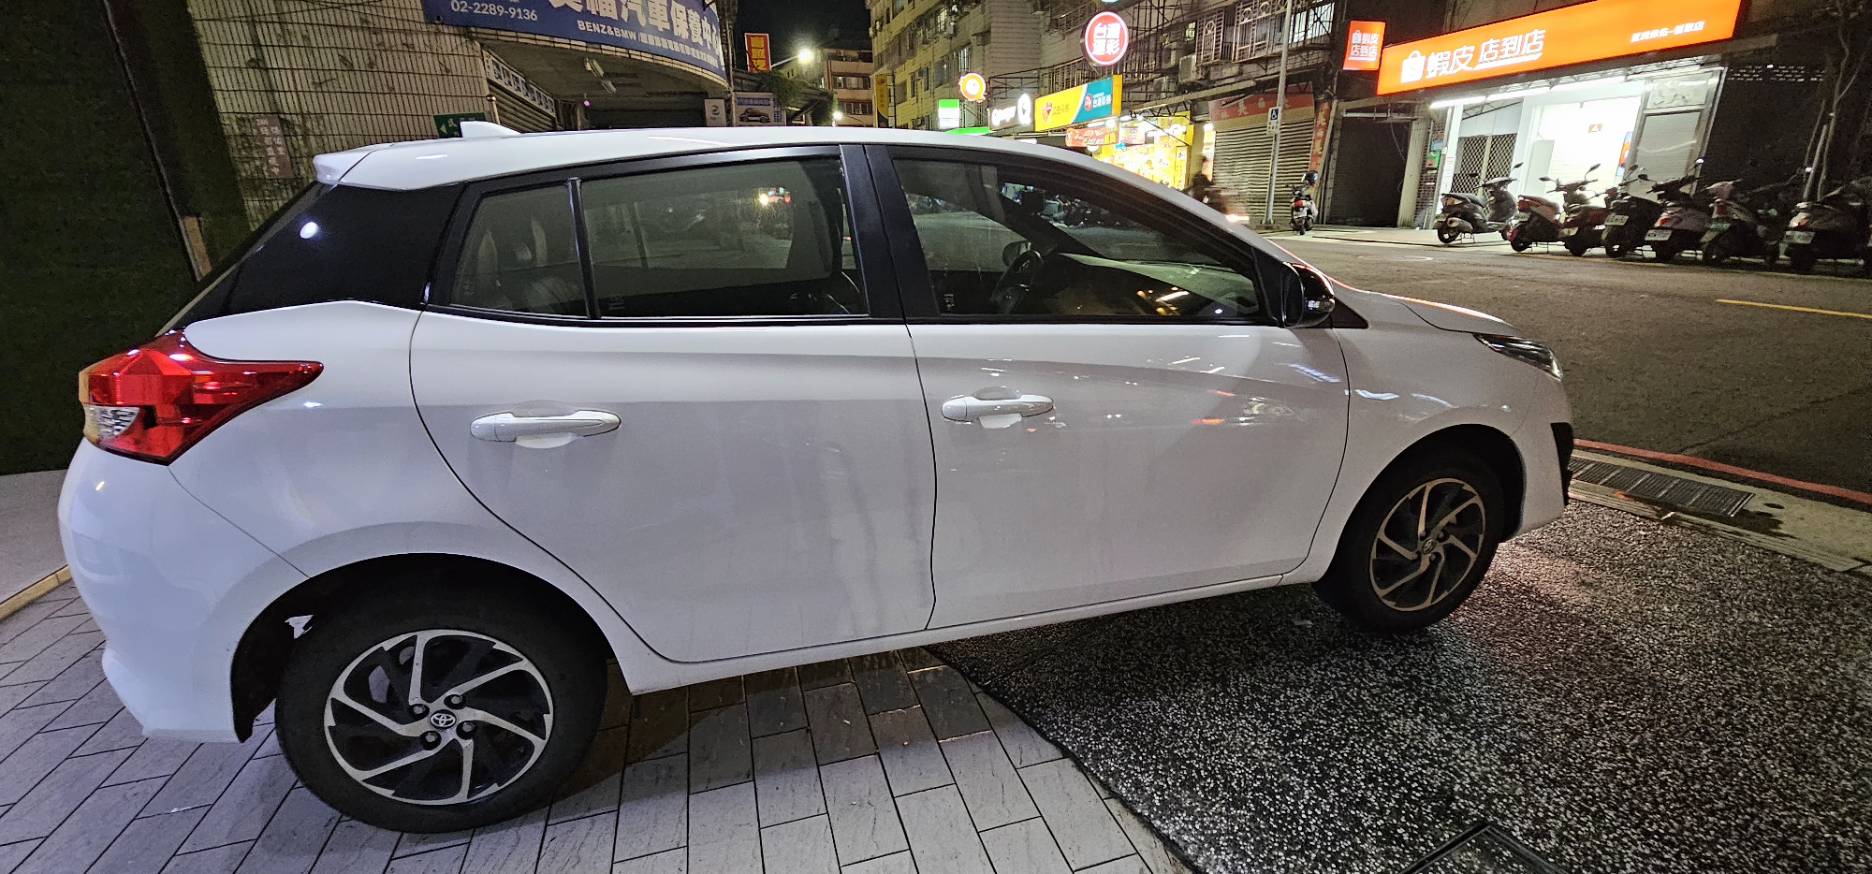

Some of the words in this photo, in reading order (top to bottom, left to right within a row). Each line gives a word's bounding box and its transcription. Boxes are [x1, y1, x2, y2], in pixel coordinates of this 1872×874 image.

[450, 0, 538, 20] 02-2289-9136
[577, 20, 637, 40] BENZ&BMW
[1426, 45, 1475, 79] 蝦皮
[1478, 29, 1546, 62] 店到店
